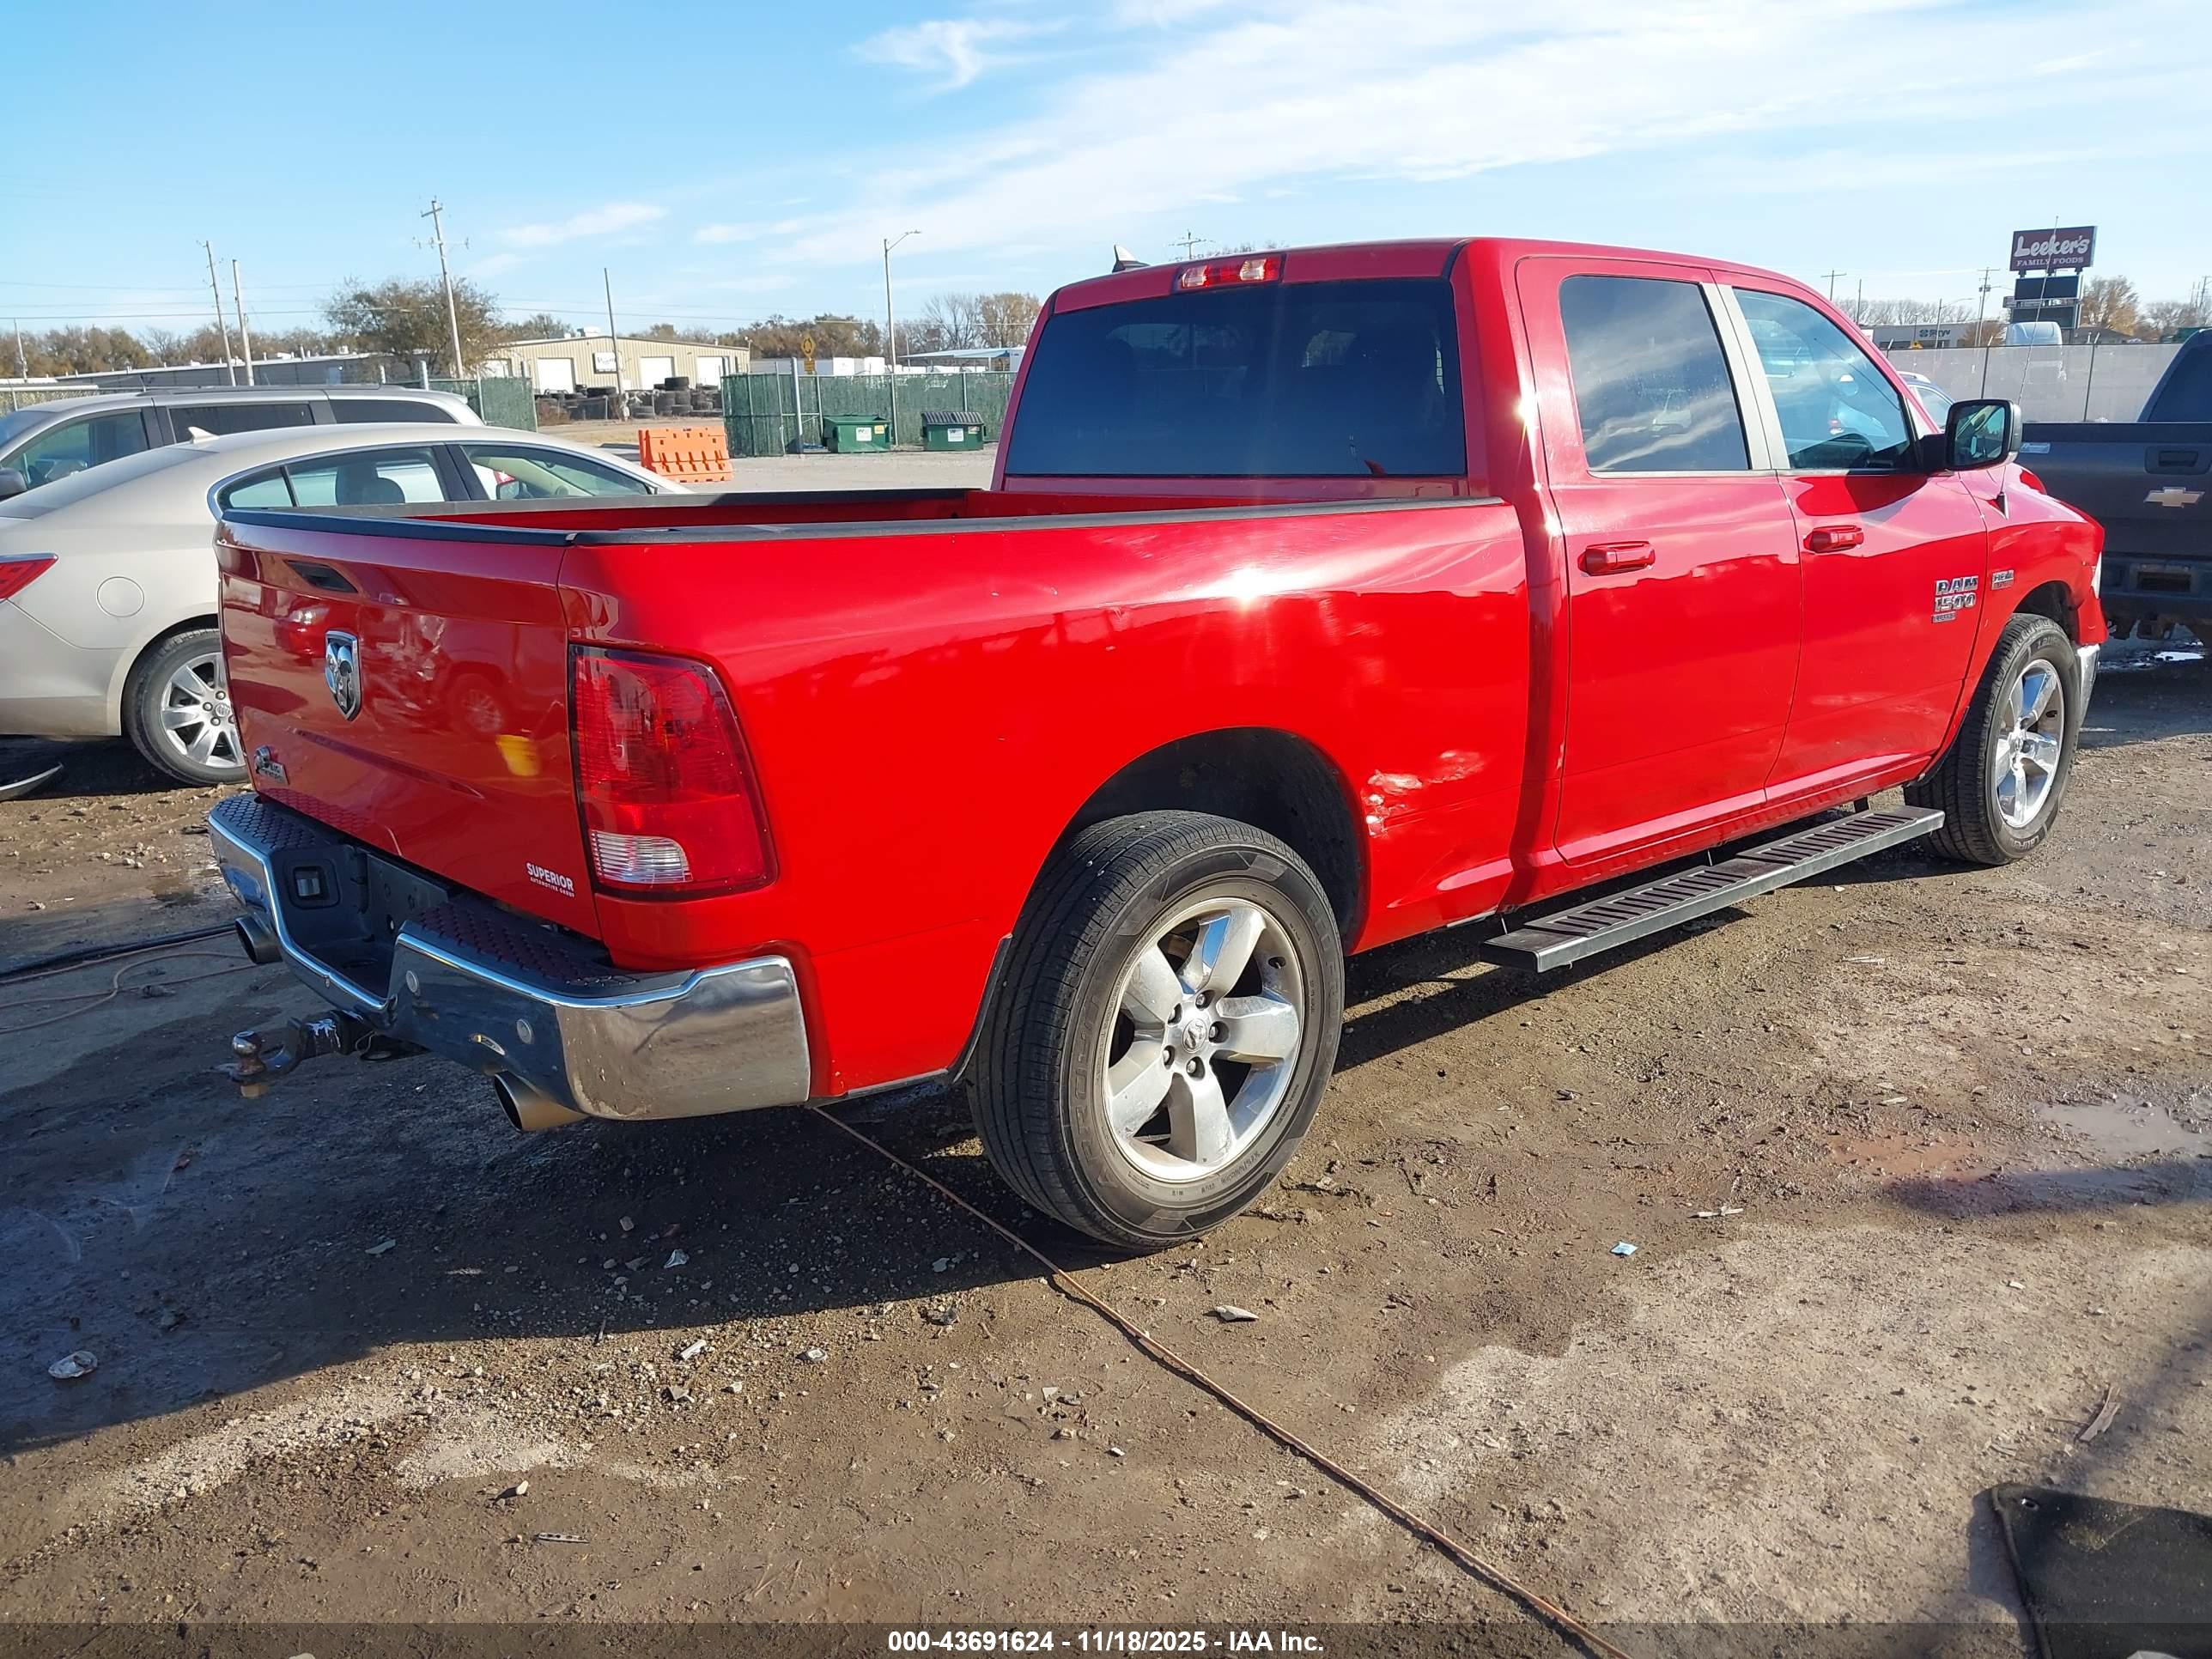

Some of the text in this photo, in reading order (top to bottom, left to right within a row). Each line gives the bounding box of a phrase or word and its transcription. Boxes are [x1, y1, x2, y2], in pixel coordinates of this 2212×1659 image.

[2014, 234, 2090, 257] Leeker's
[2016, 257, 2084, 267] FAMILY FOODS
[1936, 576, 1978, 595] RAM
[1935, 592, 1976, 611] 1500
[526, 862, 574, 892] SUPERIOR
